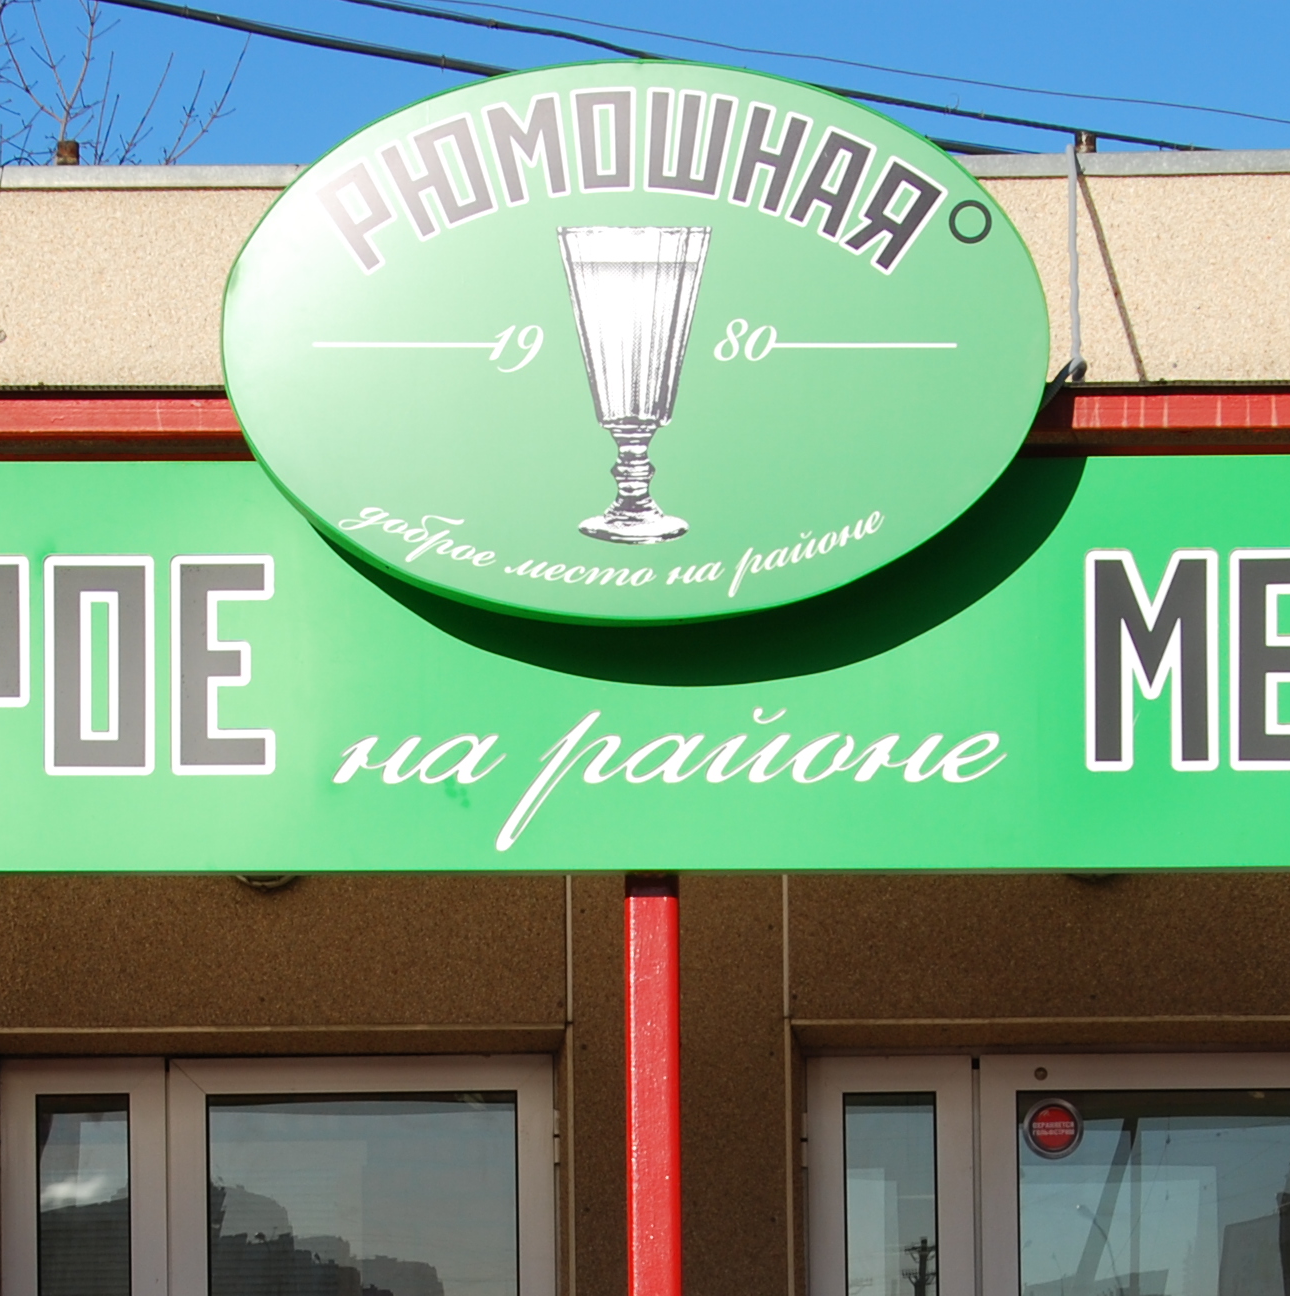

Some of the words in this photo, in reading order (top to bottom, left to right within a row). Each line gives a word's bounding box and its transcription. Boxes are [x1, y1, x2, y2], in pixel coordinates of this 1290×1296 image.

[316, 85, 948, 276] РЮМОШНАЯ
[488, 323, 545, 373] 19
[713, 318, 778, 363] 80
[338, 505, 497, 569] доброе
[505, 559, 656, 588] место
[665, 558, 727, 587] на
[729, 508, 886, 598] районе
[332, 734, 507, 785] на
[495, 705, 1008, 852] районе
